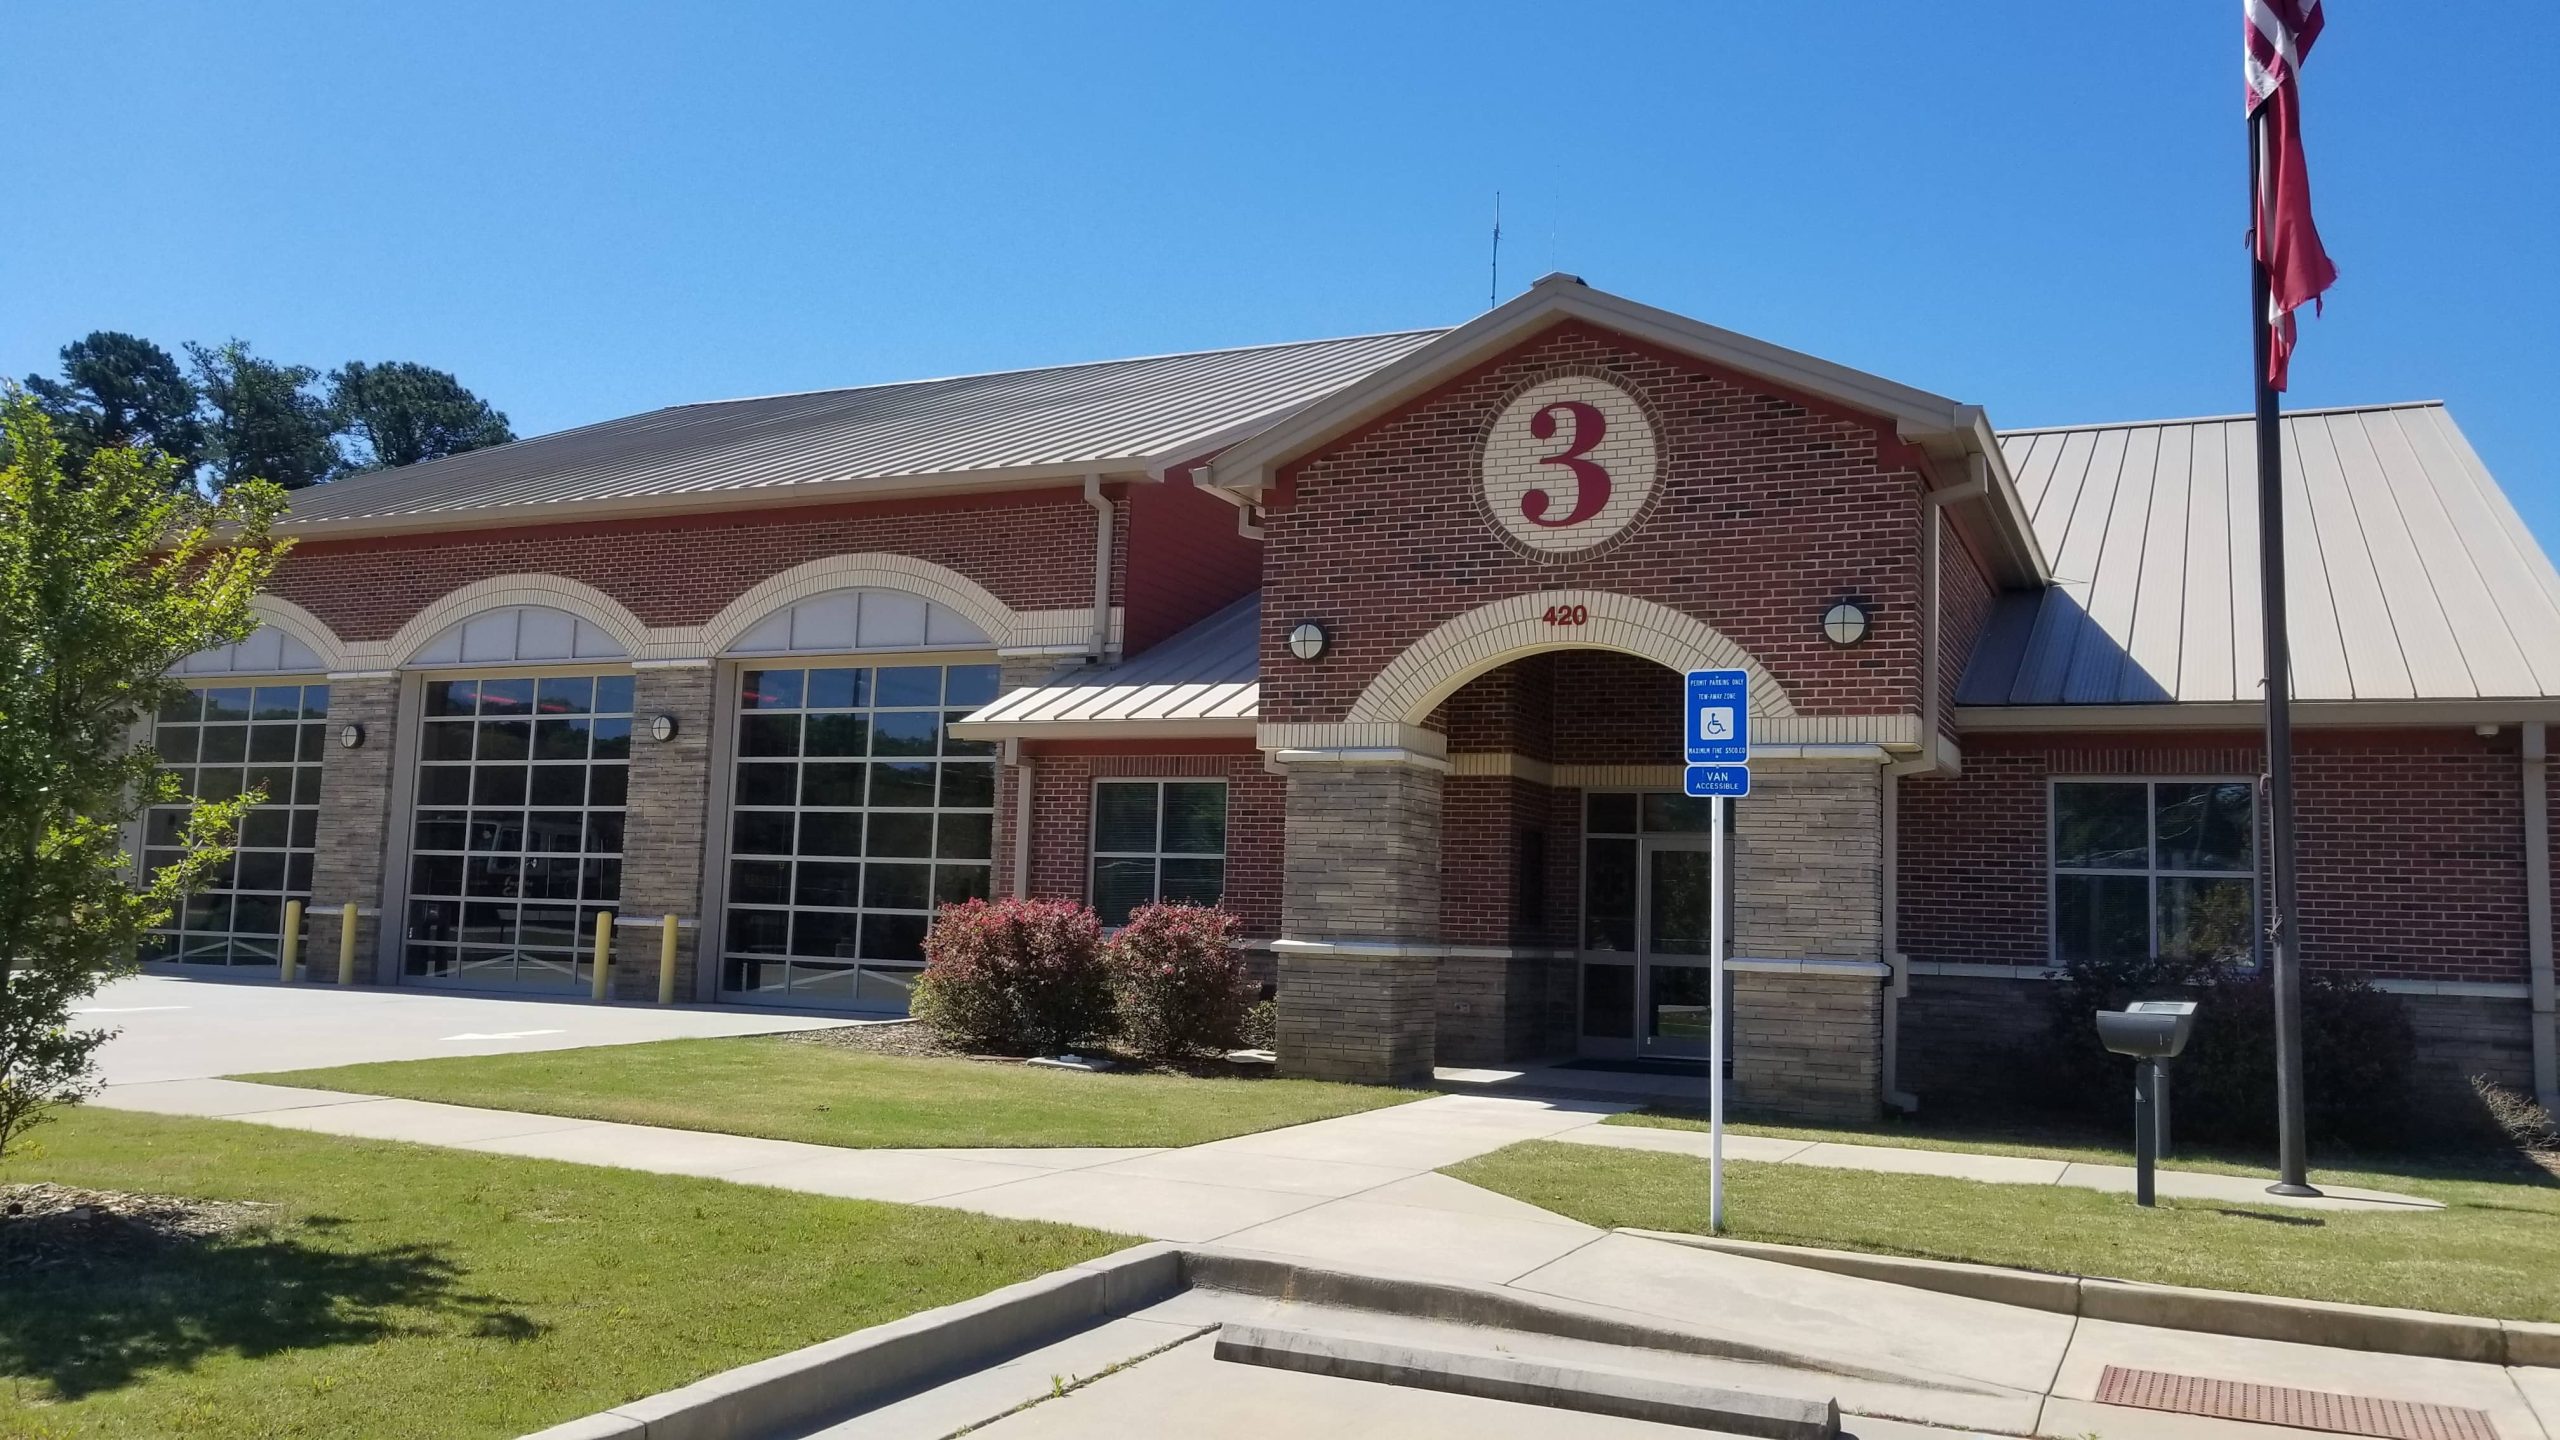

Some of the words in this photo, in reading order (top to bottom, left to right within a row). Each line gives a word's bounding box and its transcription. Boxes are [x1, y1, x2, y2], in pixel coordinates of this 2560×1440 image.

[1521, 401, 1611, 527] 3
[1542, 605, 1587, 626] 420
[1690, 679, 1707, 687] PERMIT
[1732, 678, 1744, 686] ONLY
[1706, 772, 1728, 782] VAN
[1695, 782, 1739, 790] ACCESSIBLE
